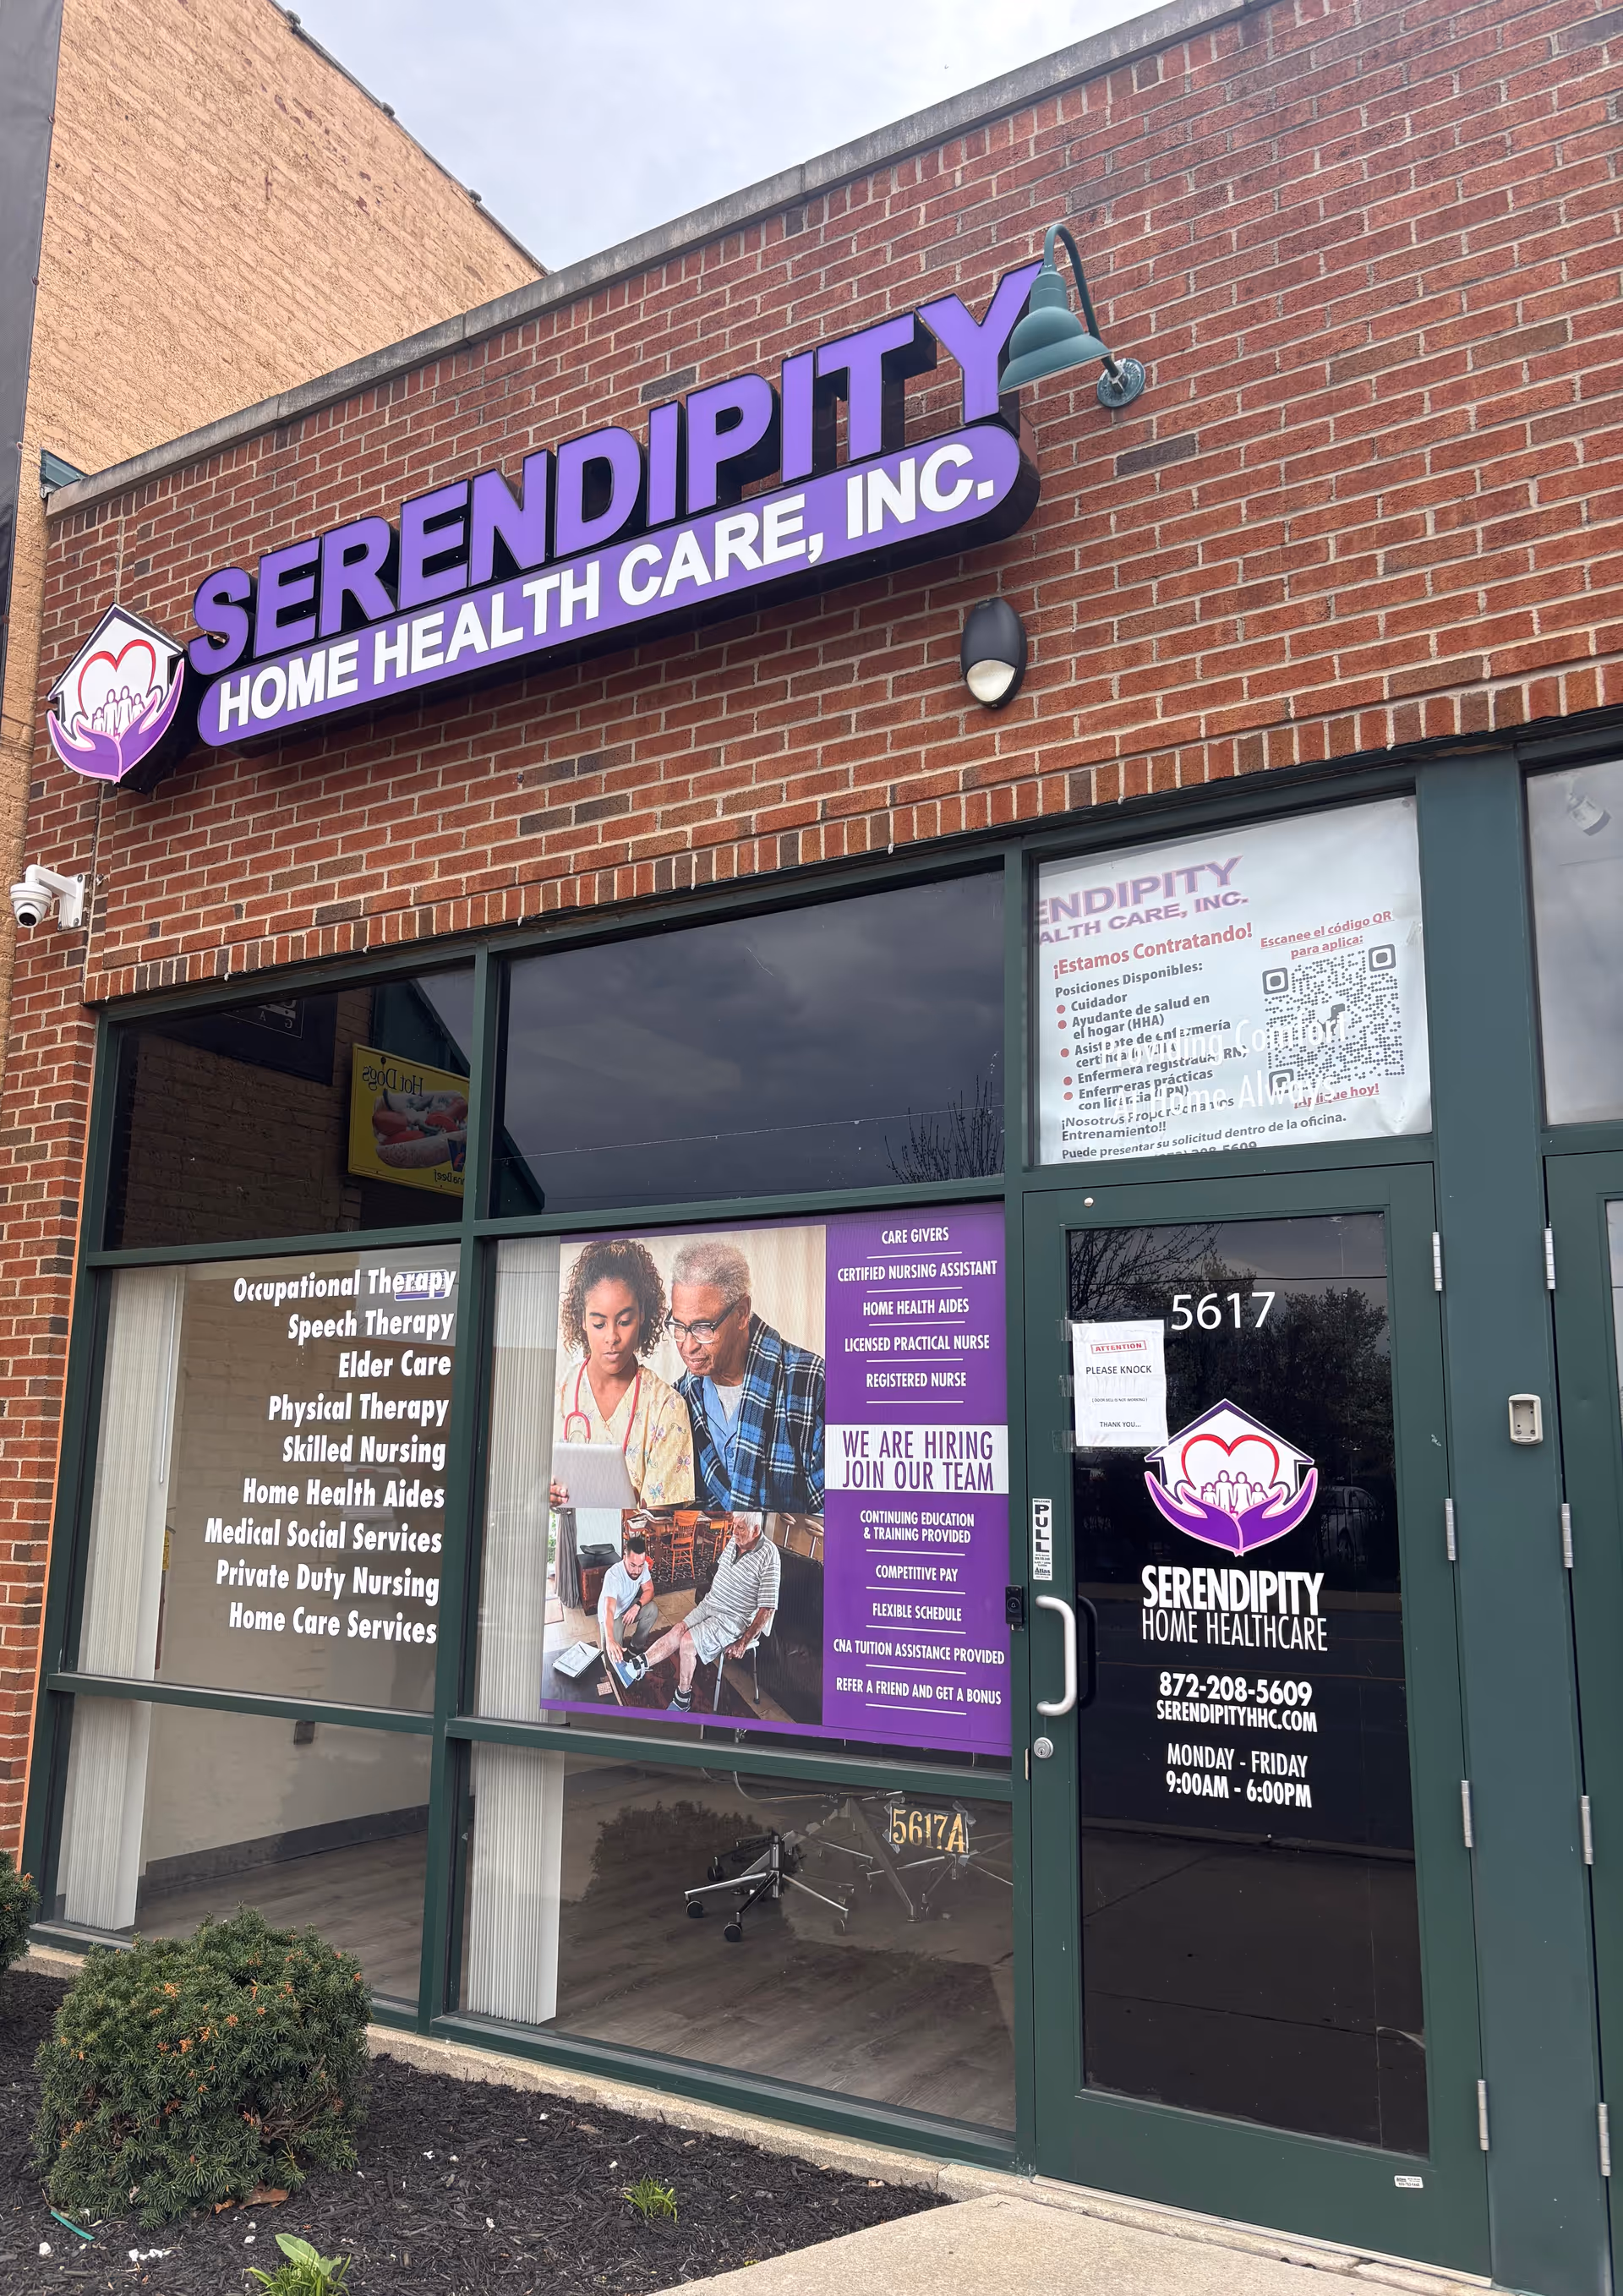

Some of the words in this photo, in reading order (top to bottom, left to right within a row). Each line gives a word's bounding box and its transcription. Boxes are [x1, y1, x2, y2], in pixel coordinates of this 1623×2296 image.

[188, 260, 1044, 675] SERENDIPITY
[218, 638, 359, 733] HOME
[373, 560, 600, 686] HEALTH
[618, 494, 824, 605] CARE,
[846, 444, 994, 539] INC.
[1108, 903, 1188, 931] CARE,
[1194, 890, 1249, 914] INC.
[1260, 931, 1311, 948] Escanee
[1313, 926, 1325, 938] el
[1327, 918, 1370, 934] código
[1372, 910, 1392, 924] QR
[1053, 948, 1130, 980] ¡Estamos
[1133, 922, 1253, 959] Contratando!
[1291, 945, 1320, 960] para
[1321, 935, 1363, 952] aplica:
[1055, 976, 1120, 998] Posiciones
[1123, 962, 1203, 985] Disponibles:
[1070, 992, 1128, 1012] Cuidador
[1072, 1007, 1133, 1030] Ayudante
[1135, 1003, 1152, 1015] de
[1154, 996, 1190, 1013] salud
[1193, 994, 1210, 1006] en
[1073, 1025, 1085, 1040] el
[1087, 1021, 1125, 1040] hogar
[1127, 1014, 1165, 1032] (HHA)
[1101, 1025, 1223, 1069] Providing
[1235, 1009, 1347, 1054] Comfort
[1136, 1032, 1152, 1045] de
[1077, 1065, 1144, 1084] Enfermera
[1219, 1045, 1248, 1061] RN)
[1079, 1080, 1151, 1100] Enfermeras
[1154, 1068, 1214, 1091] prácticas
[1150, 1083, 1227, 1118] Home
[1238, 1069, 1336, 1112] Always
[1349, 1083, 1380, 1100] hoy!
[1078, 1102, 1101, 1111] con
[1062, 1121, 1167, 1142] Entrenamiento!!
[1062, 1146, 1097, 1159] Puede
[1100, 1142, 1156, 1158] presentar
[1156, 1140, 1170, 1149] su
[1172, 1129, 1222, 1146] solicitud
[1224, 1122, 1265, 1139] dentro
[1268, 1122, 1284, 1133] de
[1286, 1119, 1298, 1130] la
[1300, 1113, 1347, 1128] oficina.
[882, 1230, 908, 1244] CARE
[910, 1227, 948, 1243] GIVERS
[233, 1270, 360, 1306] Occupational
[368, 1267, 456, 1298] Therapy
[838, 1266, 885, 1282] CERTIFIED
[888, 1263, 937, 1280] NURSING
[940, 1260, 997, 1277] ASSISTANT
[863, 1301, 893, 1315] HOME
[897, 1299, 935, 1315] HEALTH
[938, 1298, 969, 1313] AIDES
[1171, 1291, 1276, 1331] 5617
[287, 1310, 357, 1346] Speech
[365, 1309, 454, 1341] Therapy
[844, 1337, 890, 1353] LICENSED
[893, 1336, 950, 1351] PRACTICAL
[954, 1335, 990, 1350] NURSE
[338, 1351, 393, 1378] Elder
[401, 1350, 451, 1376] Care
[1095, 1342, 1143, 1352] ATTENTION
[866, 1373, 927, 1387] REGISTERED
[931, 1372, 966, 1386] NURSE
[1085, 1365, 1118, 1375] PLEASE
[1120, 1365, 1152, 1374] KNOCK
[268, 1392, 352, 1427] Physical
[359, 1392, 450, 1427] Therapy
[282, 1435, 353, 1462] Skilled
[360, 1435, 446, 1471] Nursing
[843, 1430, 869, 1457] WE
[879, 1431, 913, 1458] ARE
[925, 1431, 993, 1460] HIRING
[843, 1461, 884, 1488] JOIN
[894, 1461, 934, 1490] OUR
[943, 1462, 994, 1491] TEAM
[243, 1478, 299, 1504] Home
[306, 1479, 376, 1506] Health
[383, 1479, 445, 1509] Aides
[205, 1517, 281, 1546] Medical
[287, 1520, 346, 1549] Social
[352, 1522, 442, 1554] Services
[860, 1510, 918, 1525] CONTINUING
[921, 1512, 975, 1527] EDUCATION
[863, 1527, 871, 1539] &
[874, 1527, 919, 1541] TRAINING
[921, 1528, 970, 1544] PROVIDED
[1034, 1504, 1050, 1553] PULL
[216, 1559, 289, 1589] Private
[297, 1564, 346, 1600] Duty
[352, 1566, 440, 1607] Nursing
[876, 1565, 937, 1581] COMPETITIVE
[940, 1567, 958, 1582] PAY
[1141, 1564, 1325, 1616] SERENDIPITY
[229, 1602, 286, 1632] Home
[292, 1606, 341, 1637] Care
[347, 1610, 437, 1644] Services
[872, 1603, 912, 1618] FLEXIBLE
[915, 1605, 962, 1621] SCHEDULE
[1142, 1608, 1198, 1643] HOME
[1206, 1611, 1328, 1652] HEALTHCARE
[833, 1638, 852, 1654] CNA
[855, 1640, 892, 1656] TUITION
[895, 1643, 951, 1661] ASSISTANCE
[954, 1648, 1004, 1665] PROVIDED
[836, 1677, 863, 1692] REFER
[866, 1680, 873, 1693] A
[876, 1681, 909, 1697] FRIEND
[912, 1684, 932, 1698] AND
[936, 1686, 954, 1701] GET
[957, 1688, 964, 1702] A
[967, 1689, 1001, 1704] BONUS
[1159, 1671, 1312, 1707] 872-208-5609
[1156, 1699, 1318, 1732] SERENDIPITYHHC.COM
[1167, 1742, 1235, 1770] MONDAY
[1251, 1750, 1309, 1778] FRIDAY
[1166, 1770, 1229, 1799] 9:00AM
[1246, 1779, 1312, 1807] 6:00PM
[893, 1808, 966, 1854] 5617A
